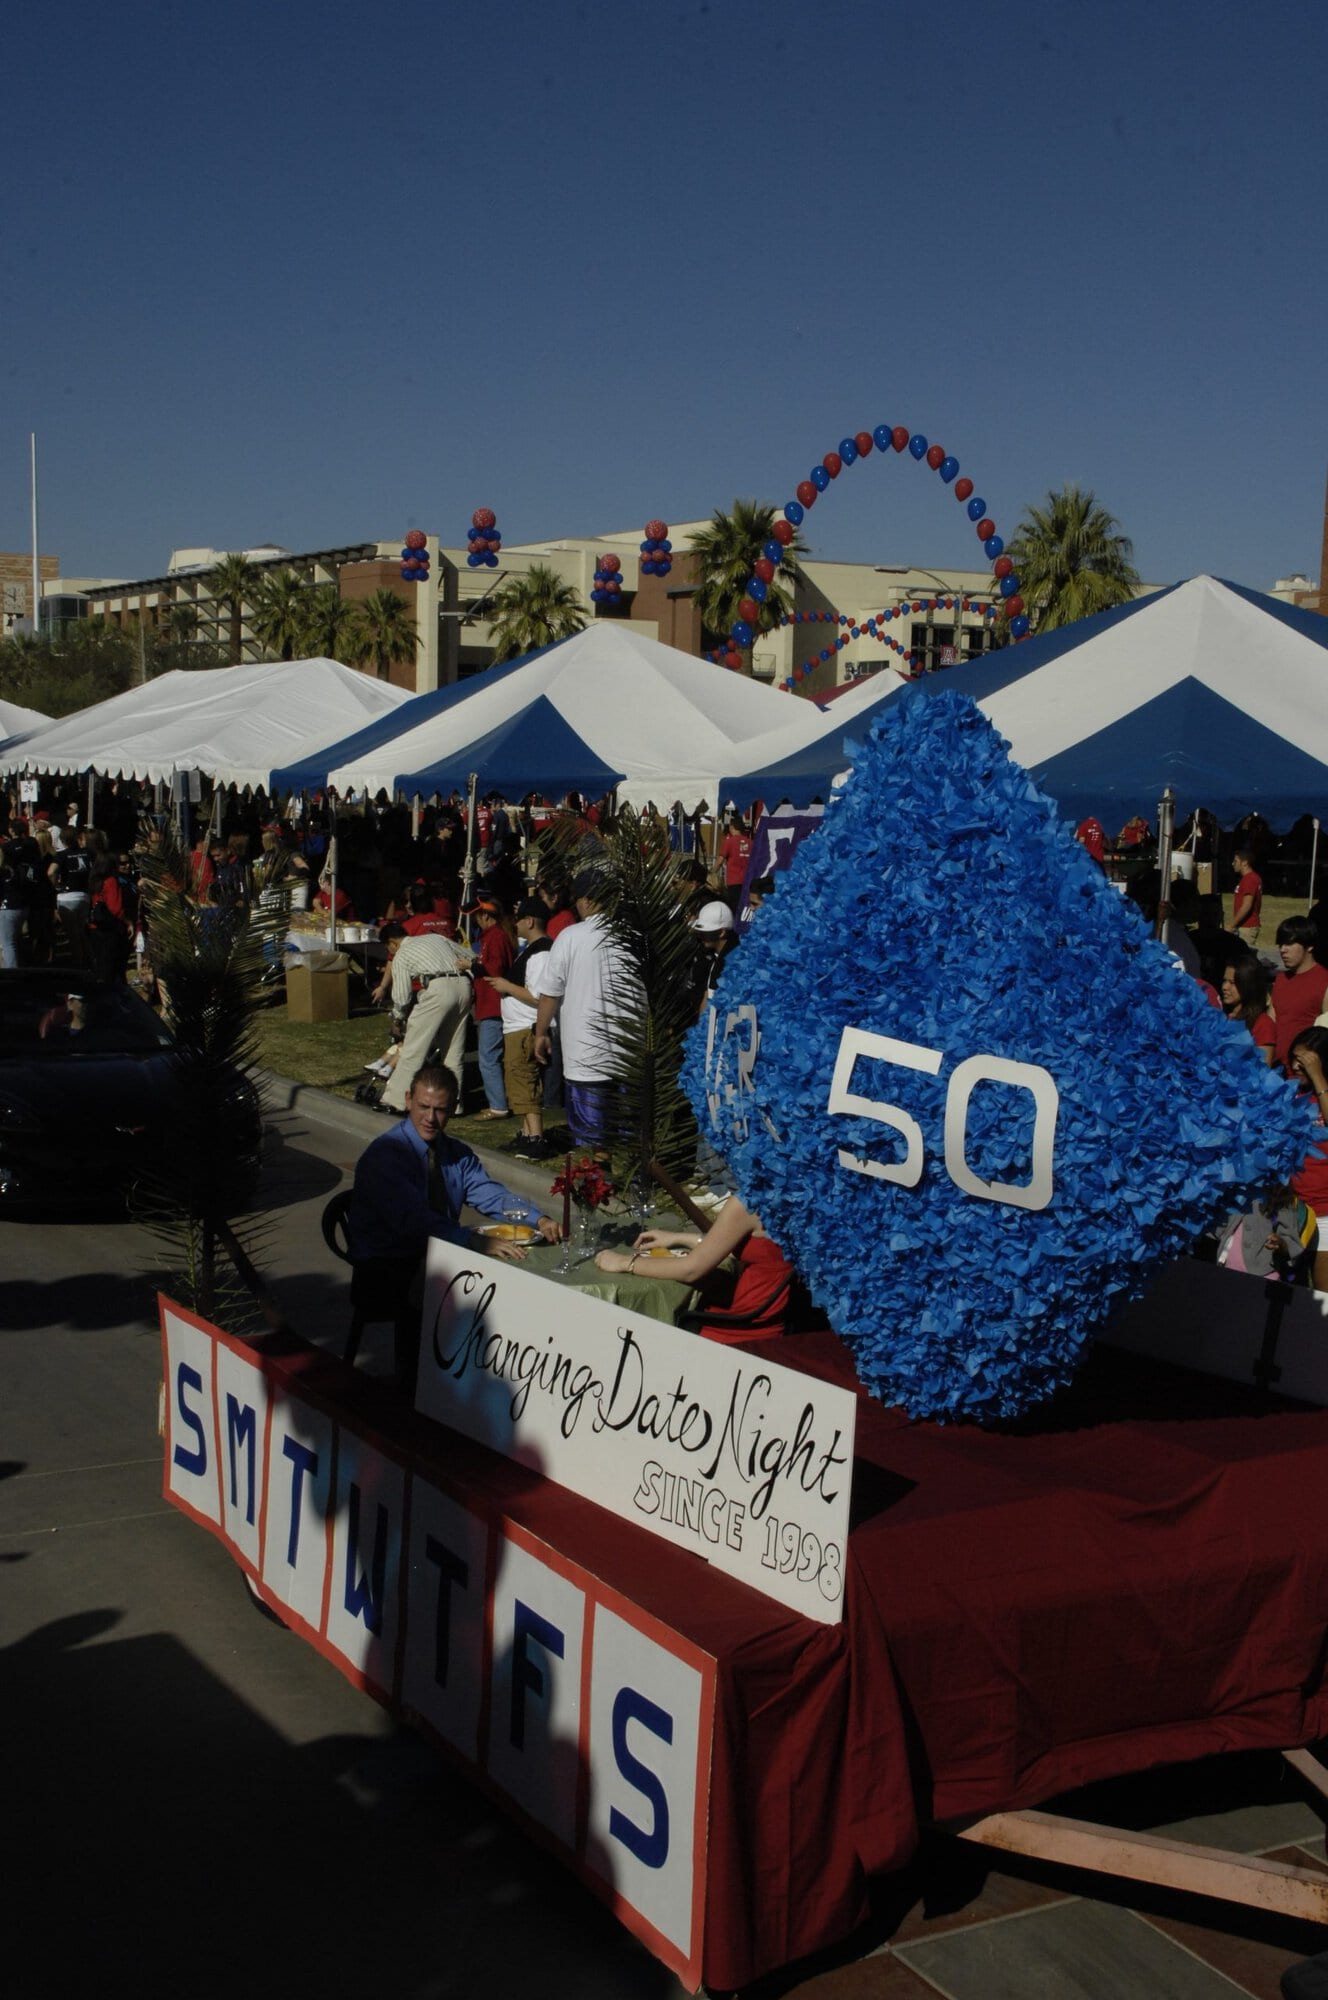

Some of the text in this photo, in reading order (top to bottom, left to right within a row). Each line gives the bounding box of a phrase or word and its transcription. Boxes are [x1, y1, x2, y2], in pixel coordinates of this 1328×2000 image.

[827, 1025, 1060, 1211] 50
[433, 1270, 848, 1520] Changing Date Night
[173, 1361, 674, 1870] S M T W T F S
[633, 1460, 843, 1602] SINCE 1998
